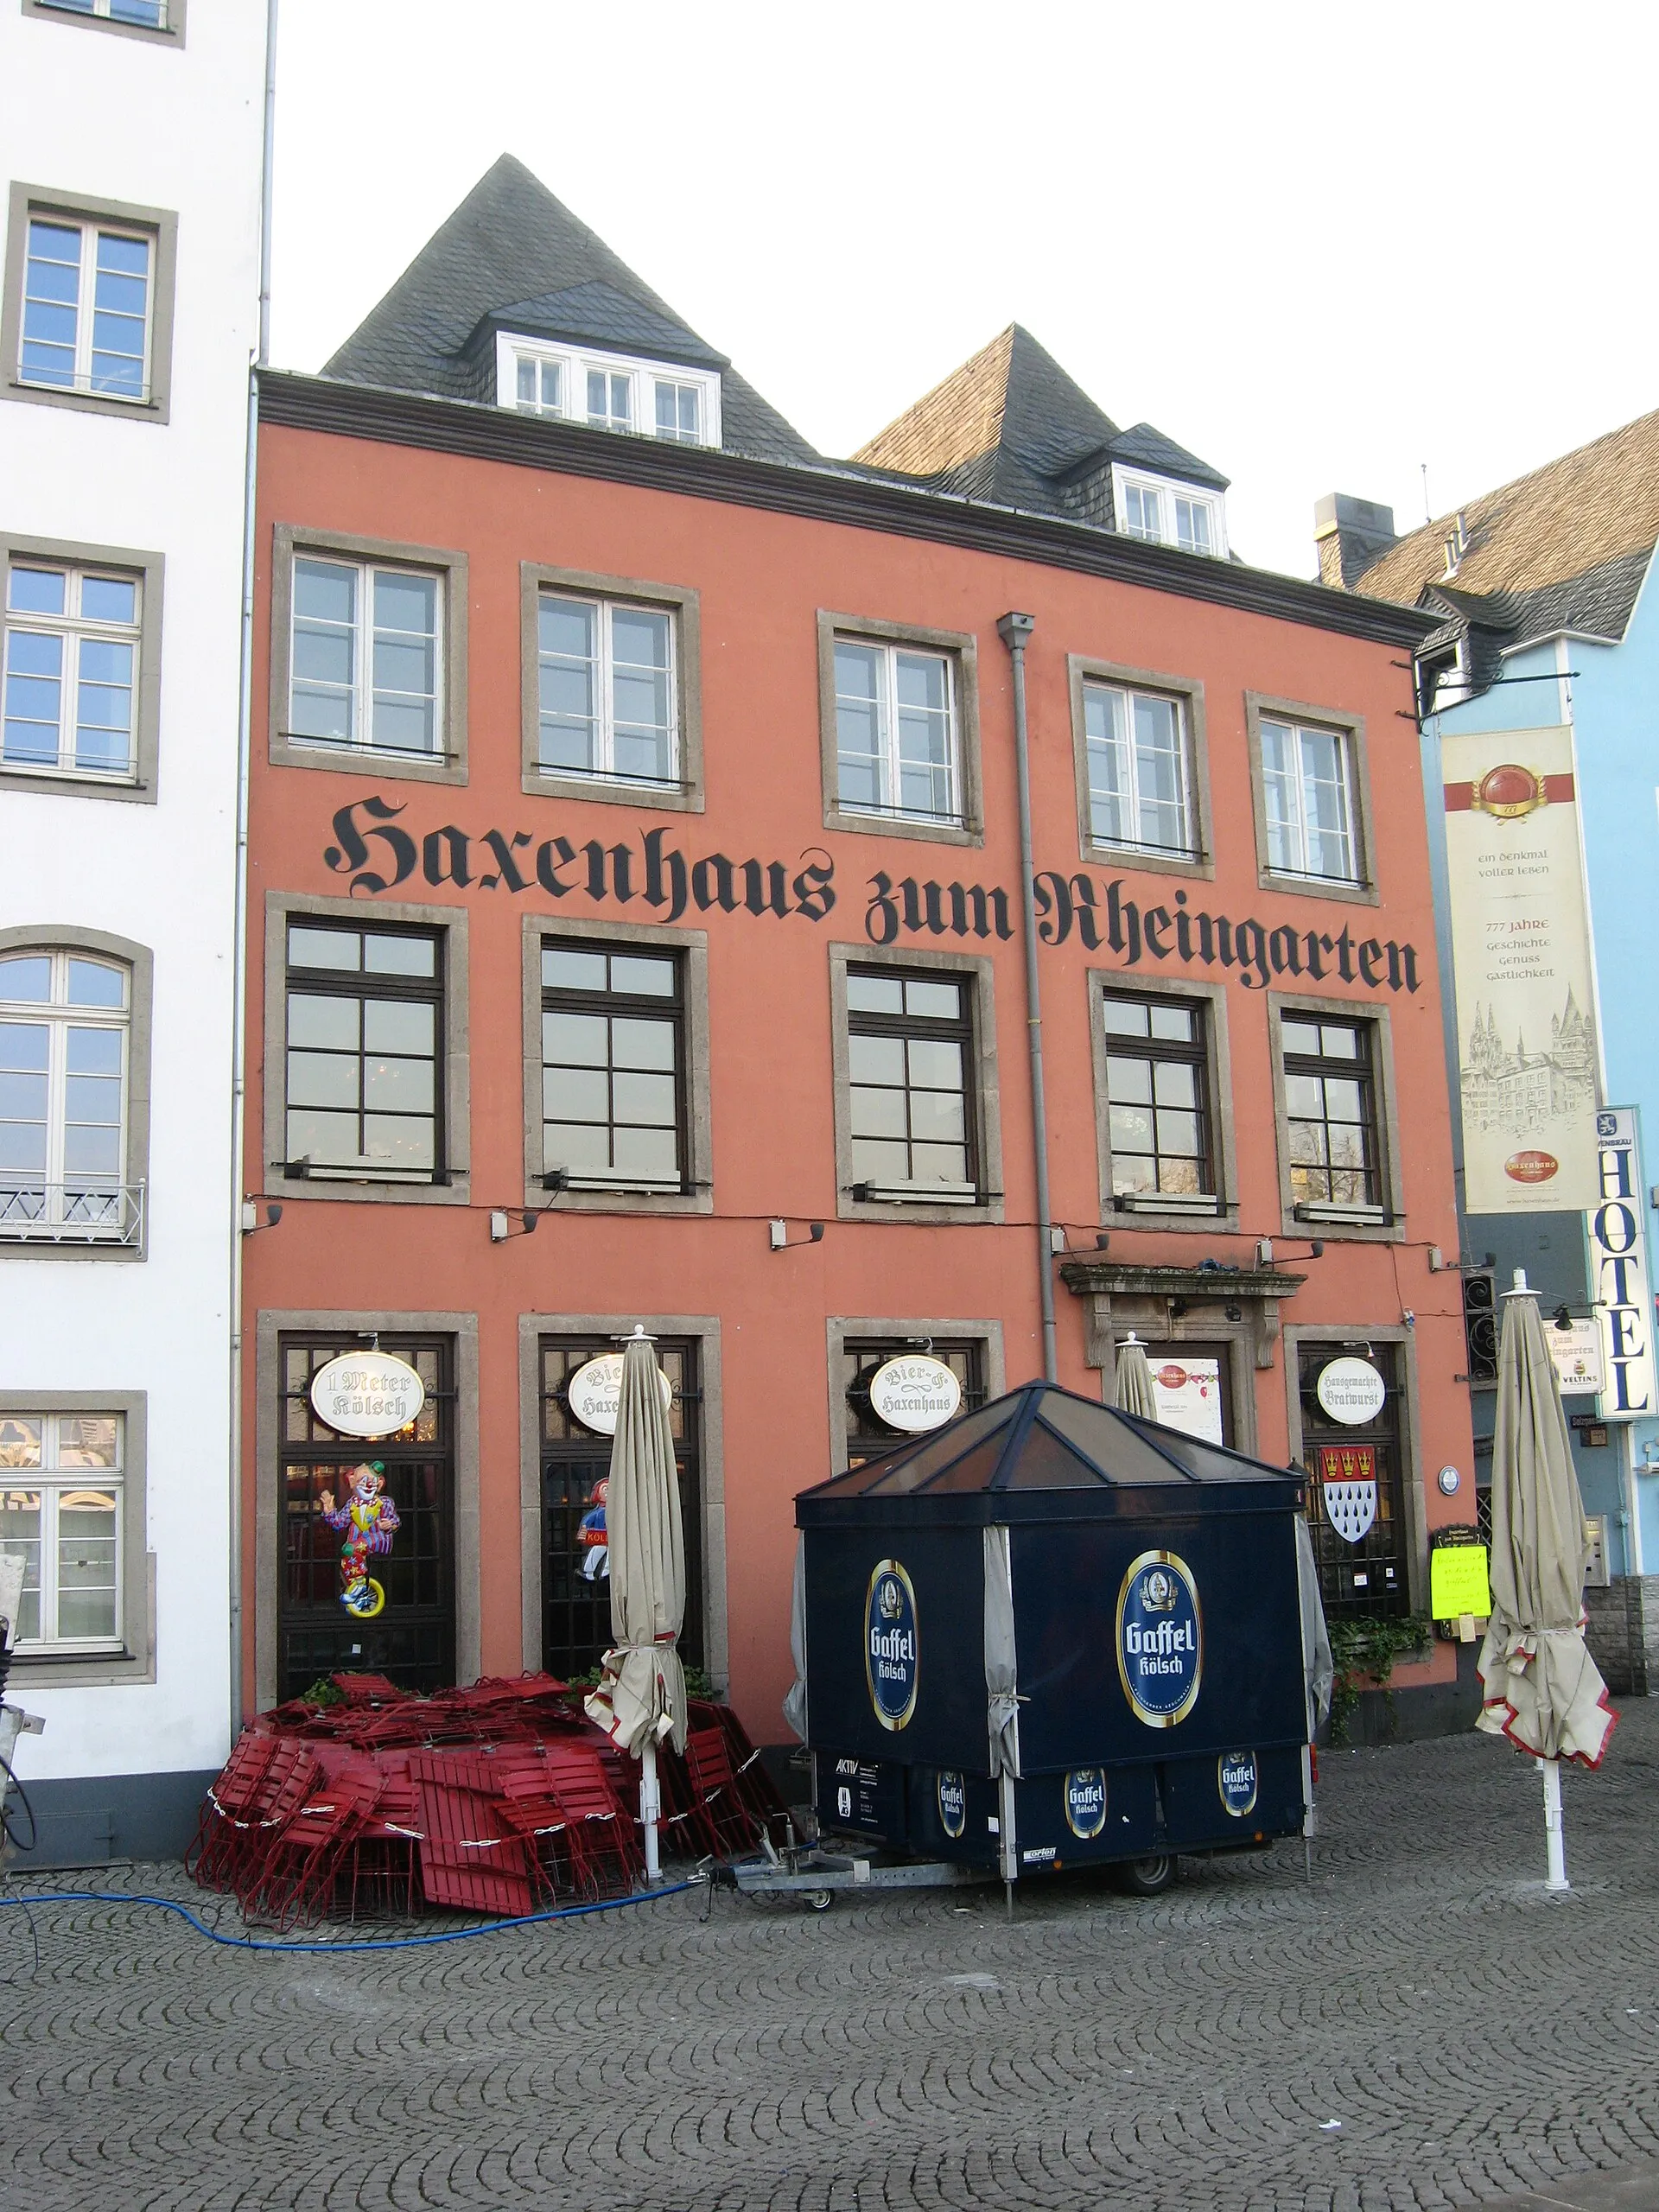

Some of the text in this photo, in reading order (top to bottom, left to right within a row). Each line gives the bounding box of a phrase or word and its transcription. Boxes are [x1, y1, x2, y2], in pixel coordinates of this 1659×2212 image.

[323, 795, 1423, 994] Haxenhaus zum Rheingarten
[1485, 921, 1505, 933] 777
[1593, 1149, 1649, 1412] HOTEL
[327, 1370, 411, 1392] 1 Meter
[586, 1363, 621, 1387] Bie
[1562, 1375, 1598, 1383] VELTINS
[332, 1395, 407, 1421] Kölsch
[882, 1395, 951, 1415] Haxenhaus
[1324, 1390, 1380, 1406] Bratwurst
[870, 1626, 915, 1662] Gaffel
[1126, 1618, 1196, 1656] Gaffel
[878, 1660, 907, 1683] Kölsch
[1140, 1655, 1184, 1676] Kölsch
[836, 1758, 859, 1775] AKTIV
[1222, 1765, 1255, 1783] Gaffel
[940, 1785, 963, 1804] Gaffel
[1069, 1784, 1103, 1804] Gaffel
[1229, 1782, 1249, 1794] Kölsch
[1076, 1803, 1098, 1815] Kölsch
